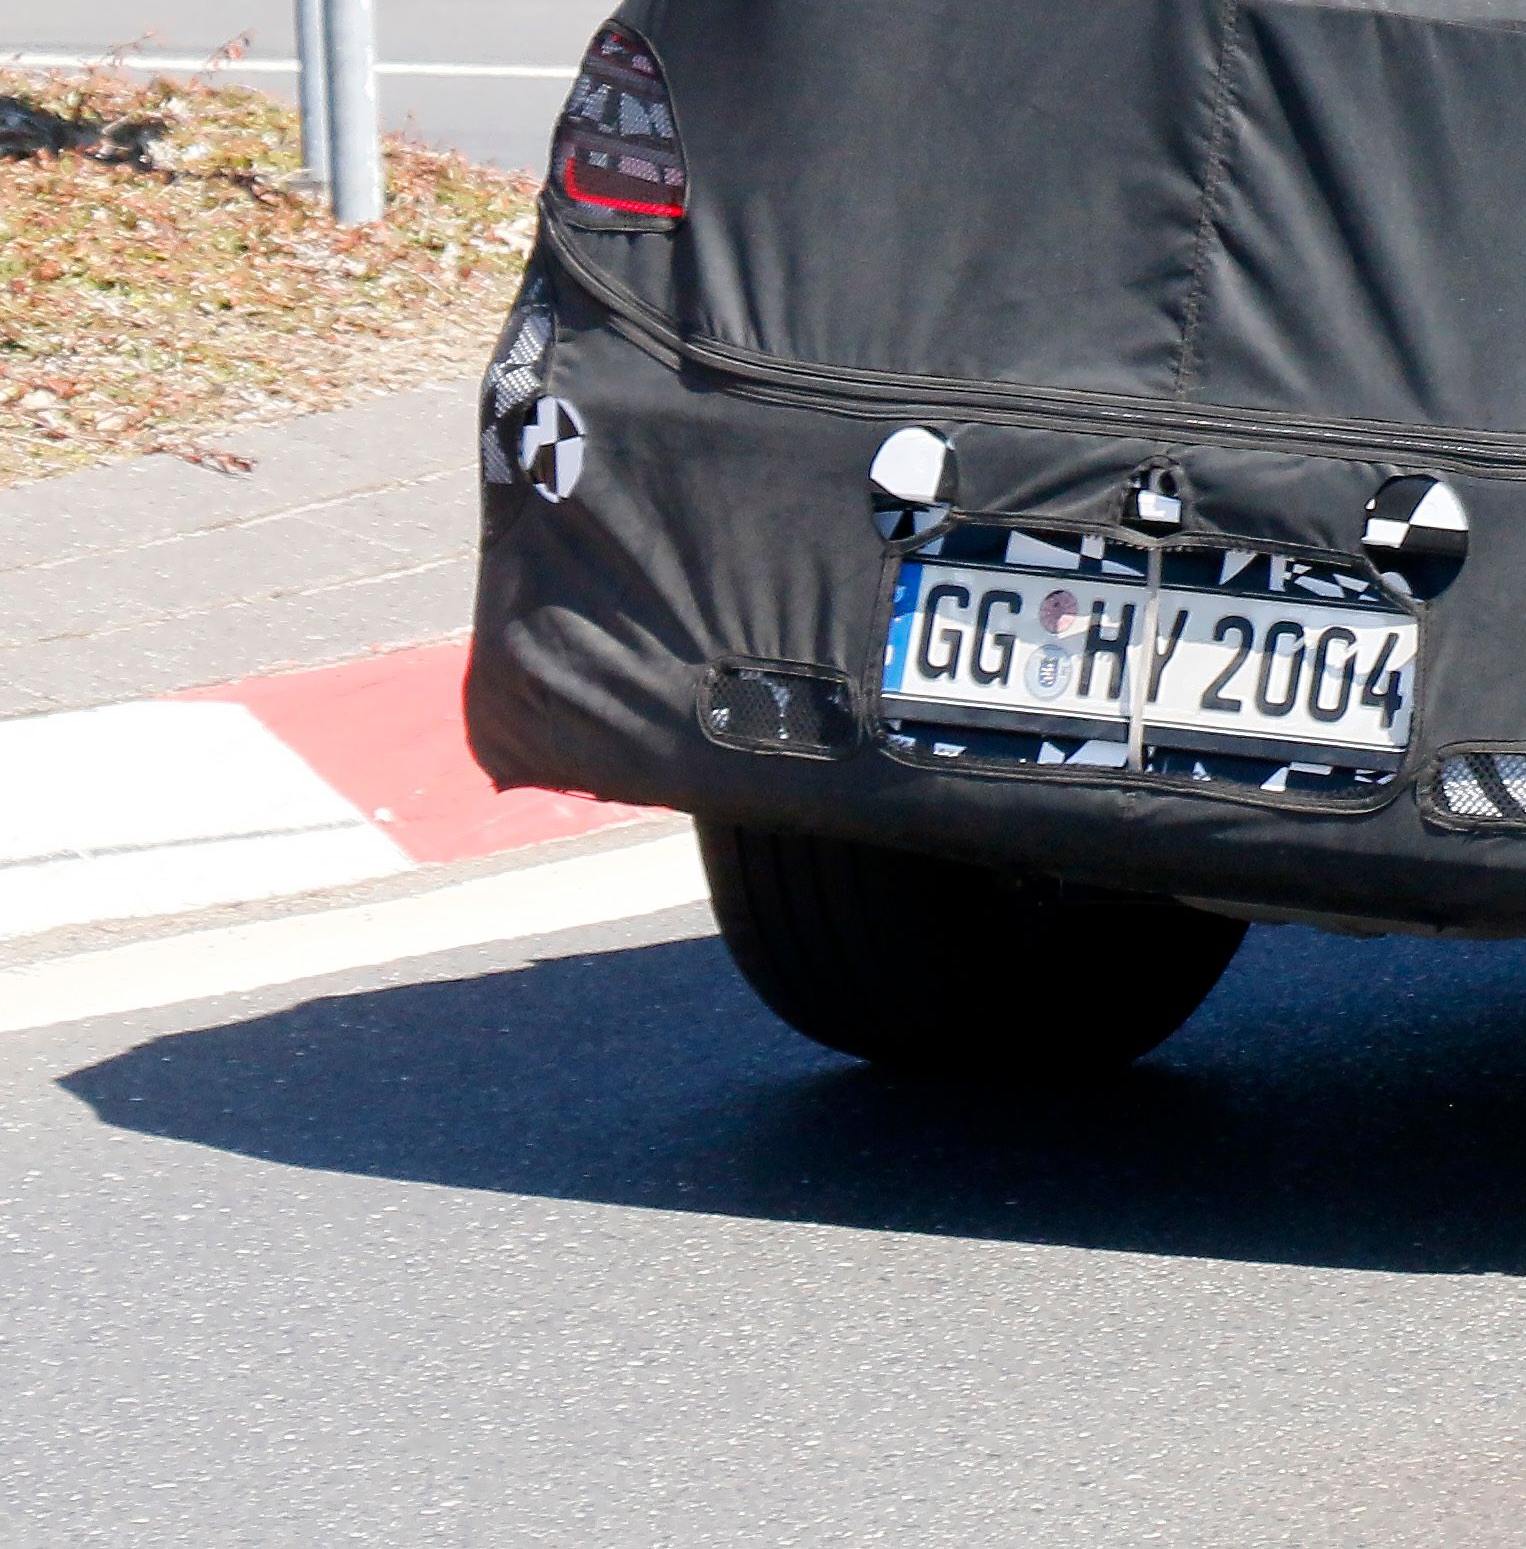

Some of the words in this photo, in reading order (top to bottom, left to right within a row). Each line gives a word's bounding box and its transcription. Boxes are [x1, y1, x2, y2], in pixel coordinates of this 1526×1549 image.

[917, 583, 1023, 686] GG
[1077, 600, 1189, 703] HY
[1200, 615, 1403, 728] 2004
